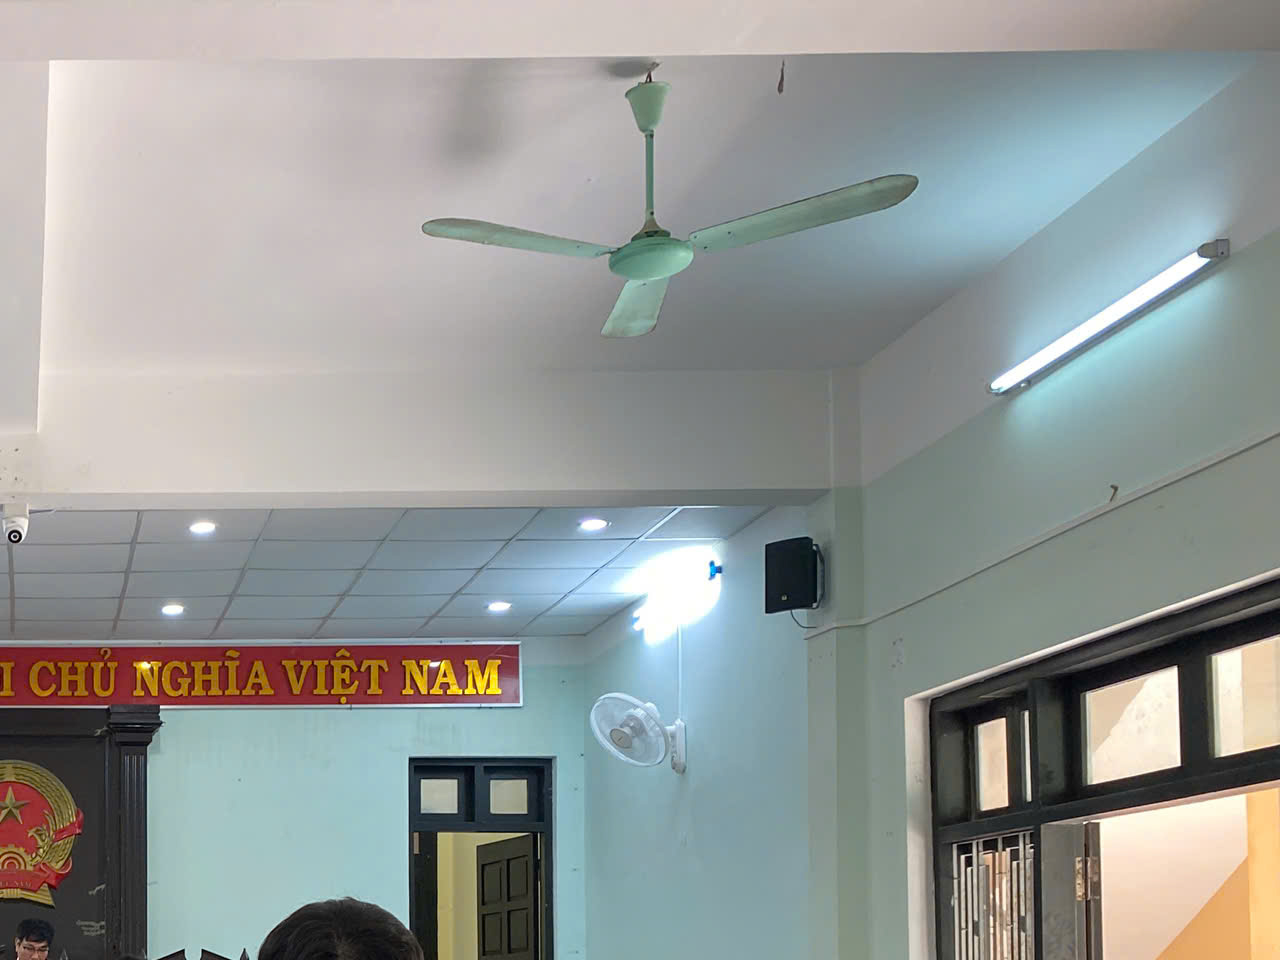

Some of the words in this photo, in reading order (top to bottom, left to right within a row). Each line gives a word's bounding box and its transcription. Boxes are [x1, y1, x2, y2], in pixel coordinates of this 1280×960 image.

[29, 648, 117, 697] CHỦ
[133, 649, 274, 697] NGHĨA
[282, 648, 388, 704] VIỆT
[402, 658, 502, 696] NAM
